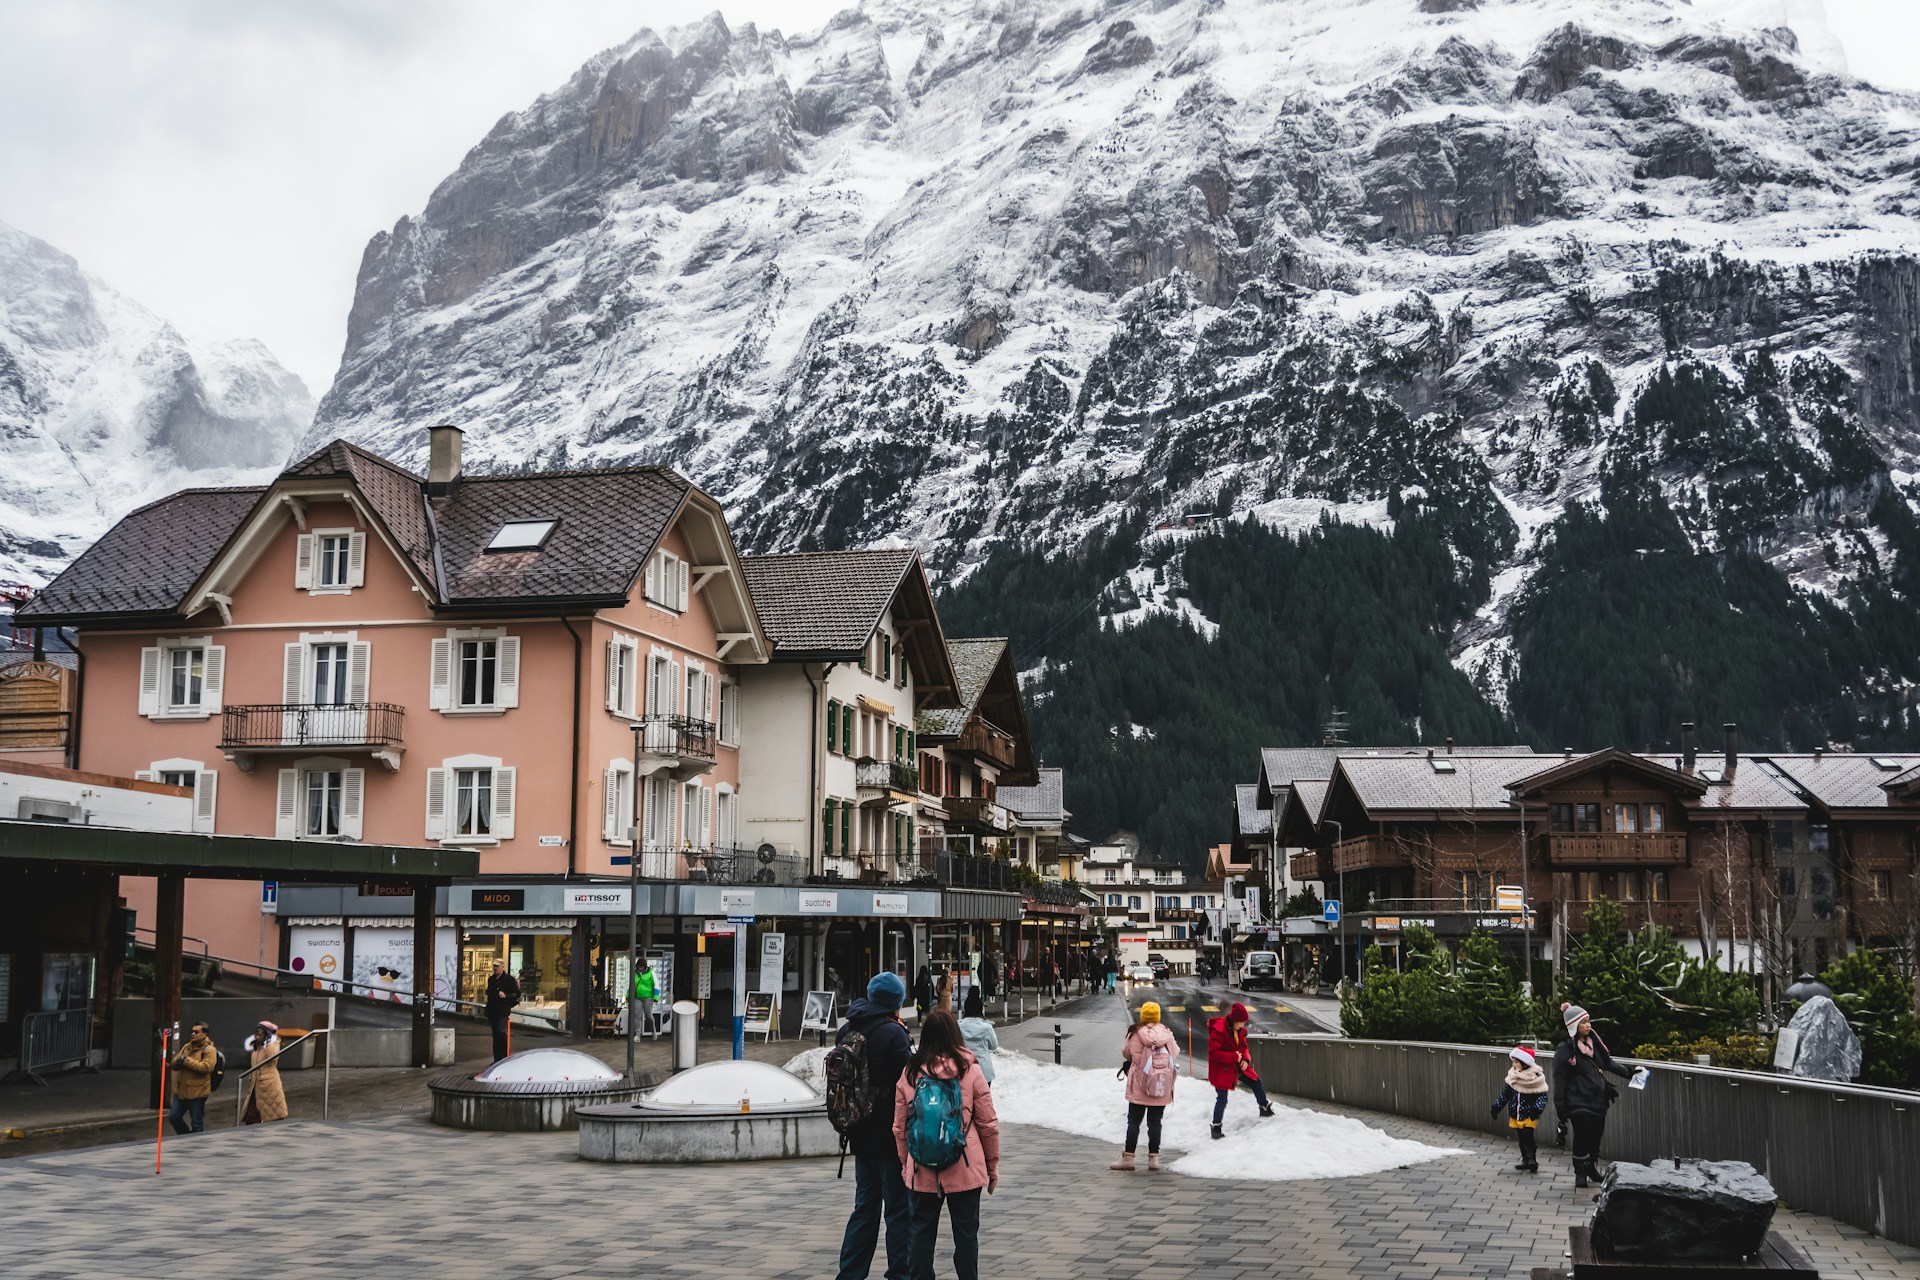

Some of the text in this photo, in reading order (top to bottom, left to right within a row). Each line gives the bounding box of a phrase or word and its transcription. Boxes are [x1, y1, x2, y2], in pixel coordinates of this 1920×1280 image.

[380, 887, 412, 895] POLICE
[483, 894, 511, 903] MIDO
[804, 899, 826, 907] swatch
[388, 939, 415, 947] swatc
